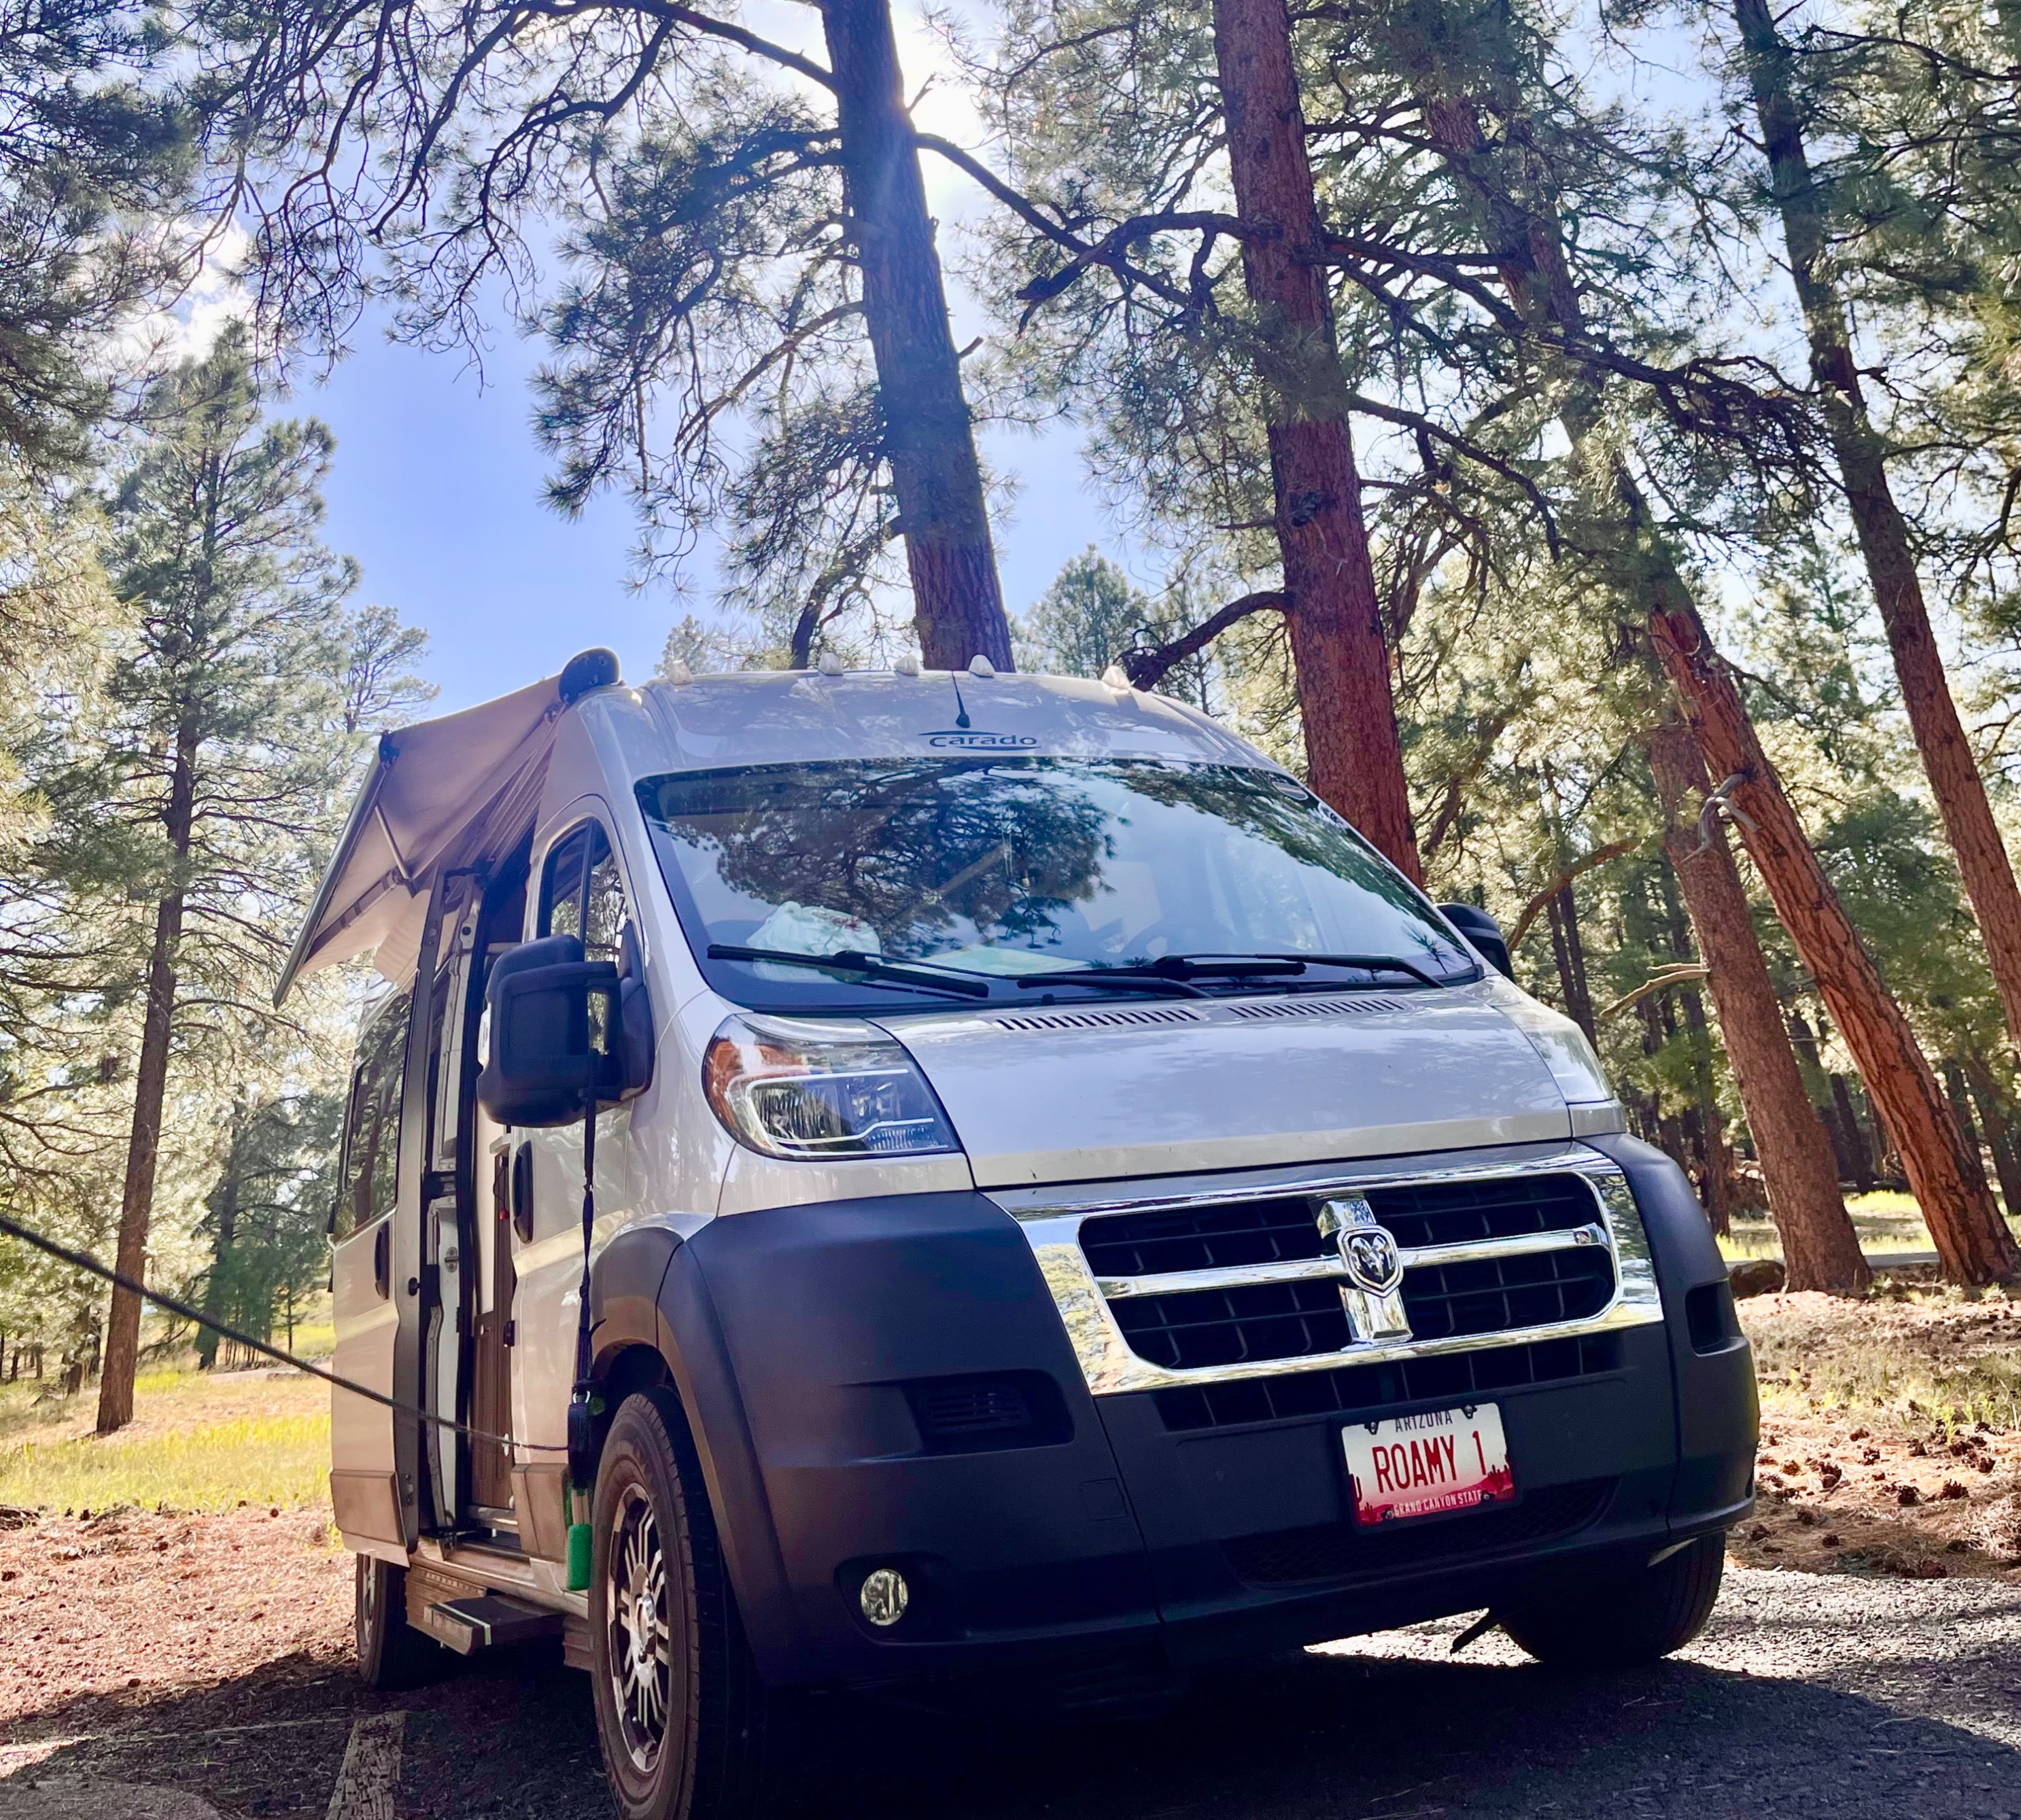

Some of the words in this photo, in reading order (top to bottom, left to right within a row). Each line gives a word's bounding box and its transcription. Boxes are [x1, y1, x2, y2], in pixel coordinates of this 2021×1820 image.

[1396, 1411, 1453, 1432] ARIZONA
[1372, 1435, 1457, 1493] ROAMY
[1472, 1431, 1486, 1475] 1
[1394, 1500, 1422, 1516] GRAND
[1423, 1494, 1457, 1510] CANYON
